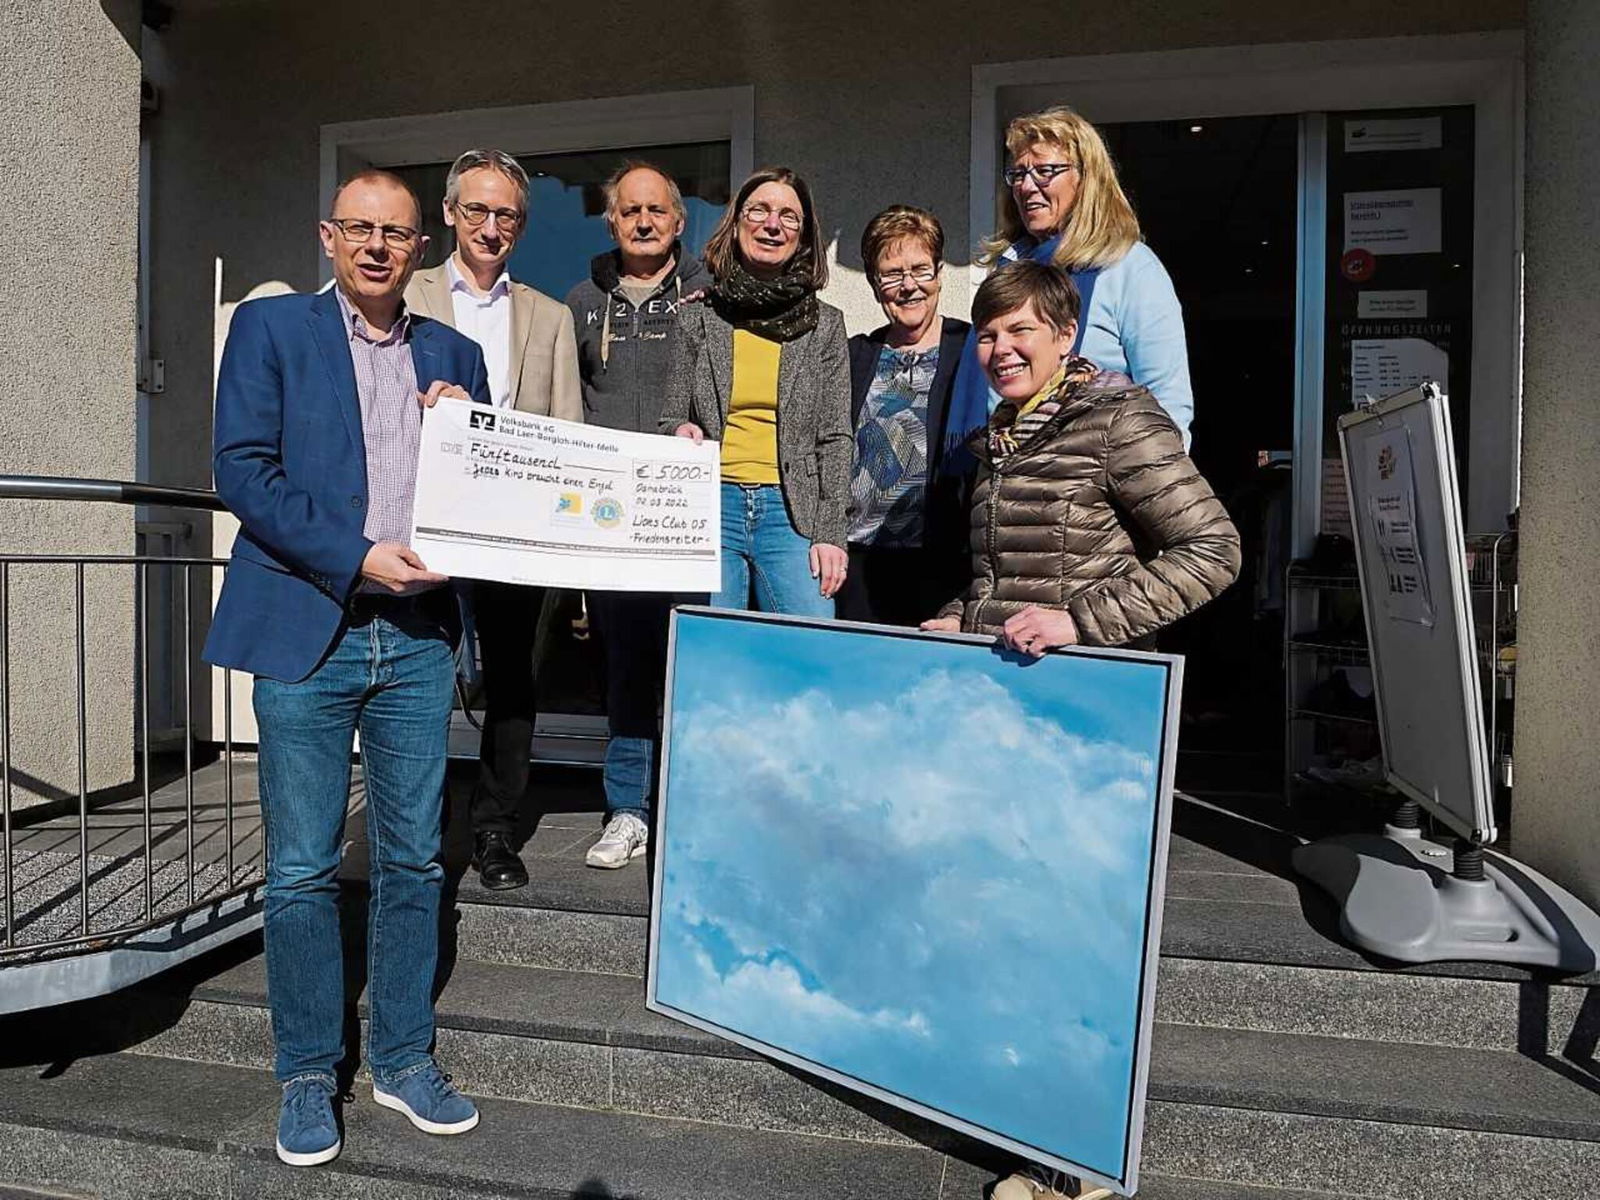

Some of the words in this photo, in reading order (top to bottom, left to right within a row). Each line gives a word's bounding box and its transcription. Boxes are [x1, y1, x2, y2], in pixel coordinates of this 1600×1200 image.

[499, 425, 515, 435] Bad
[500, 416, 541, 431] Volksbank
[470, 442, 562, 470] Fünftausend
[636, 465, 650, 479] €
[661, 514, 688, 529] Club
